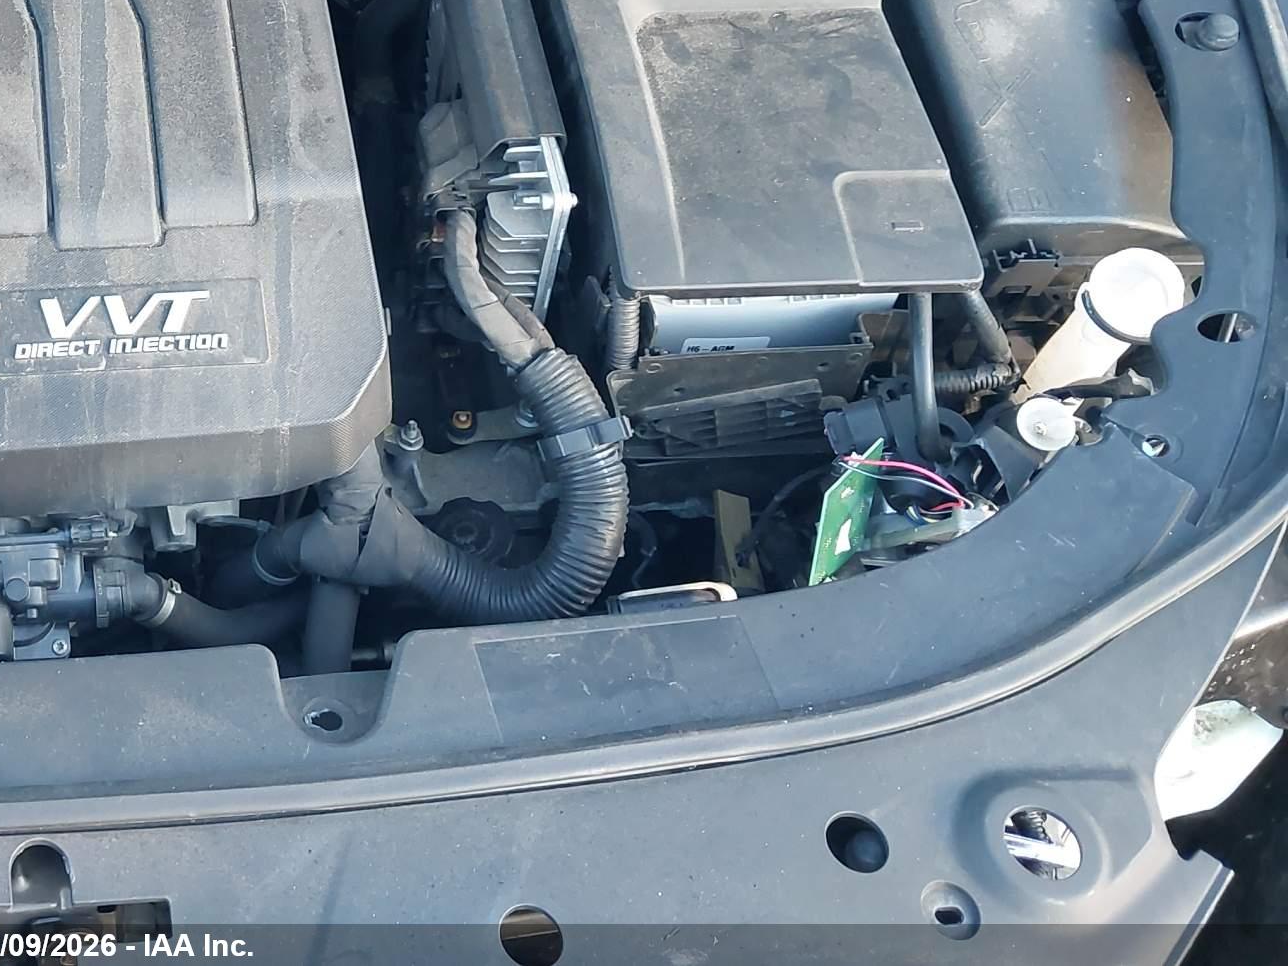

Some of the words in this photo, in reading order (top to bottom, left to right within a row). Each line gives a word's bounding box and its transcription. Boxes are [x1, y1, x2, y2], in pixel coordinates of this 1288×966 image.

[40, 290, 211, 339] VVT
[14, 337, 101, 360] DIRECT
[109, 333, 229, 355] INJECTION
